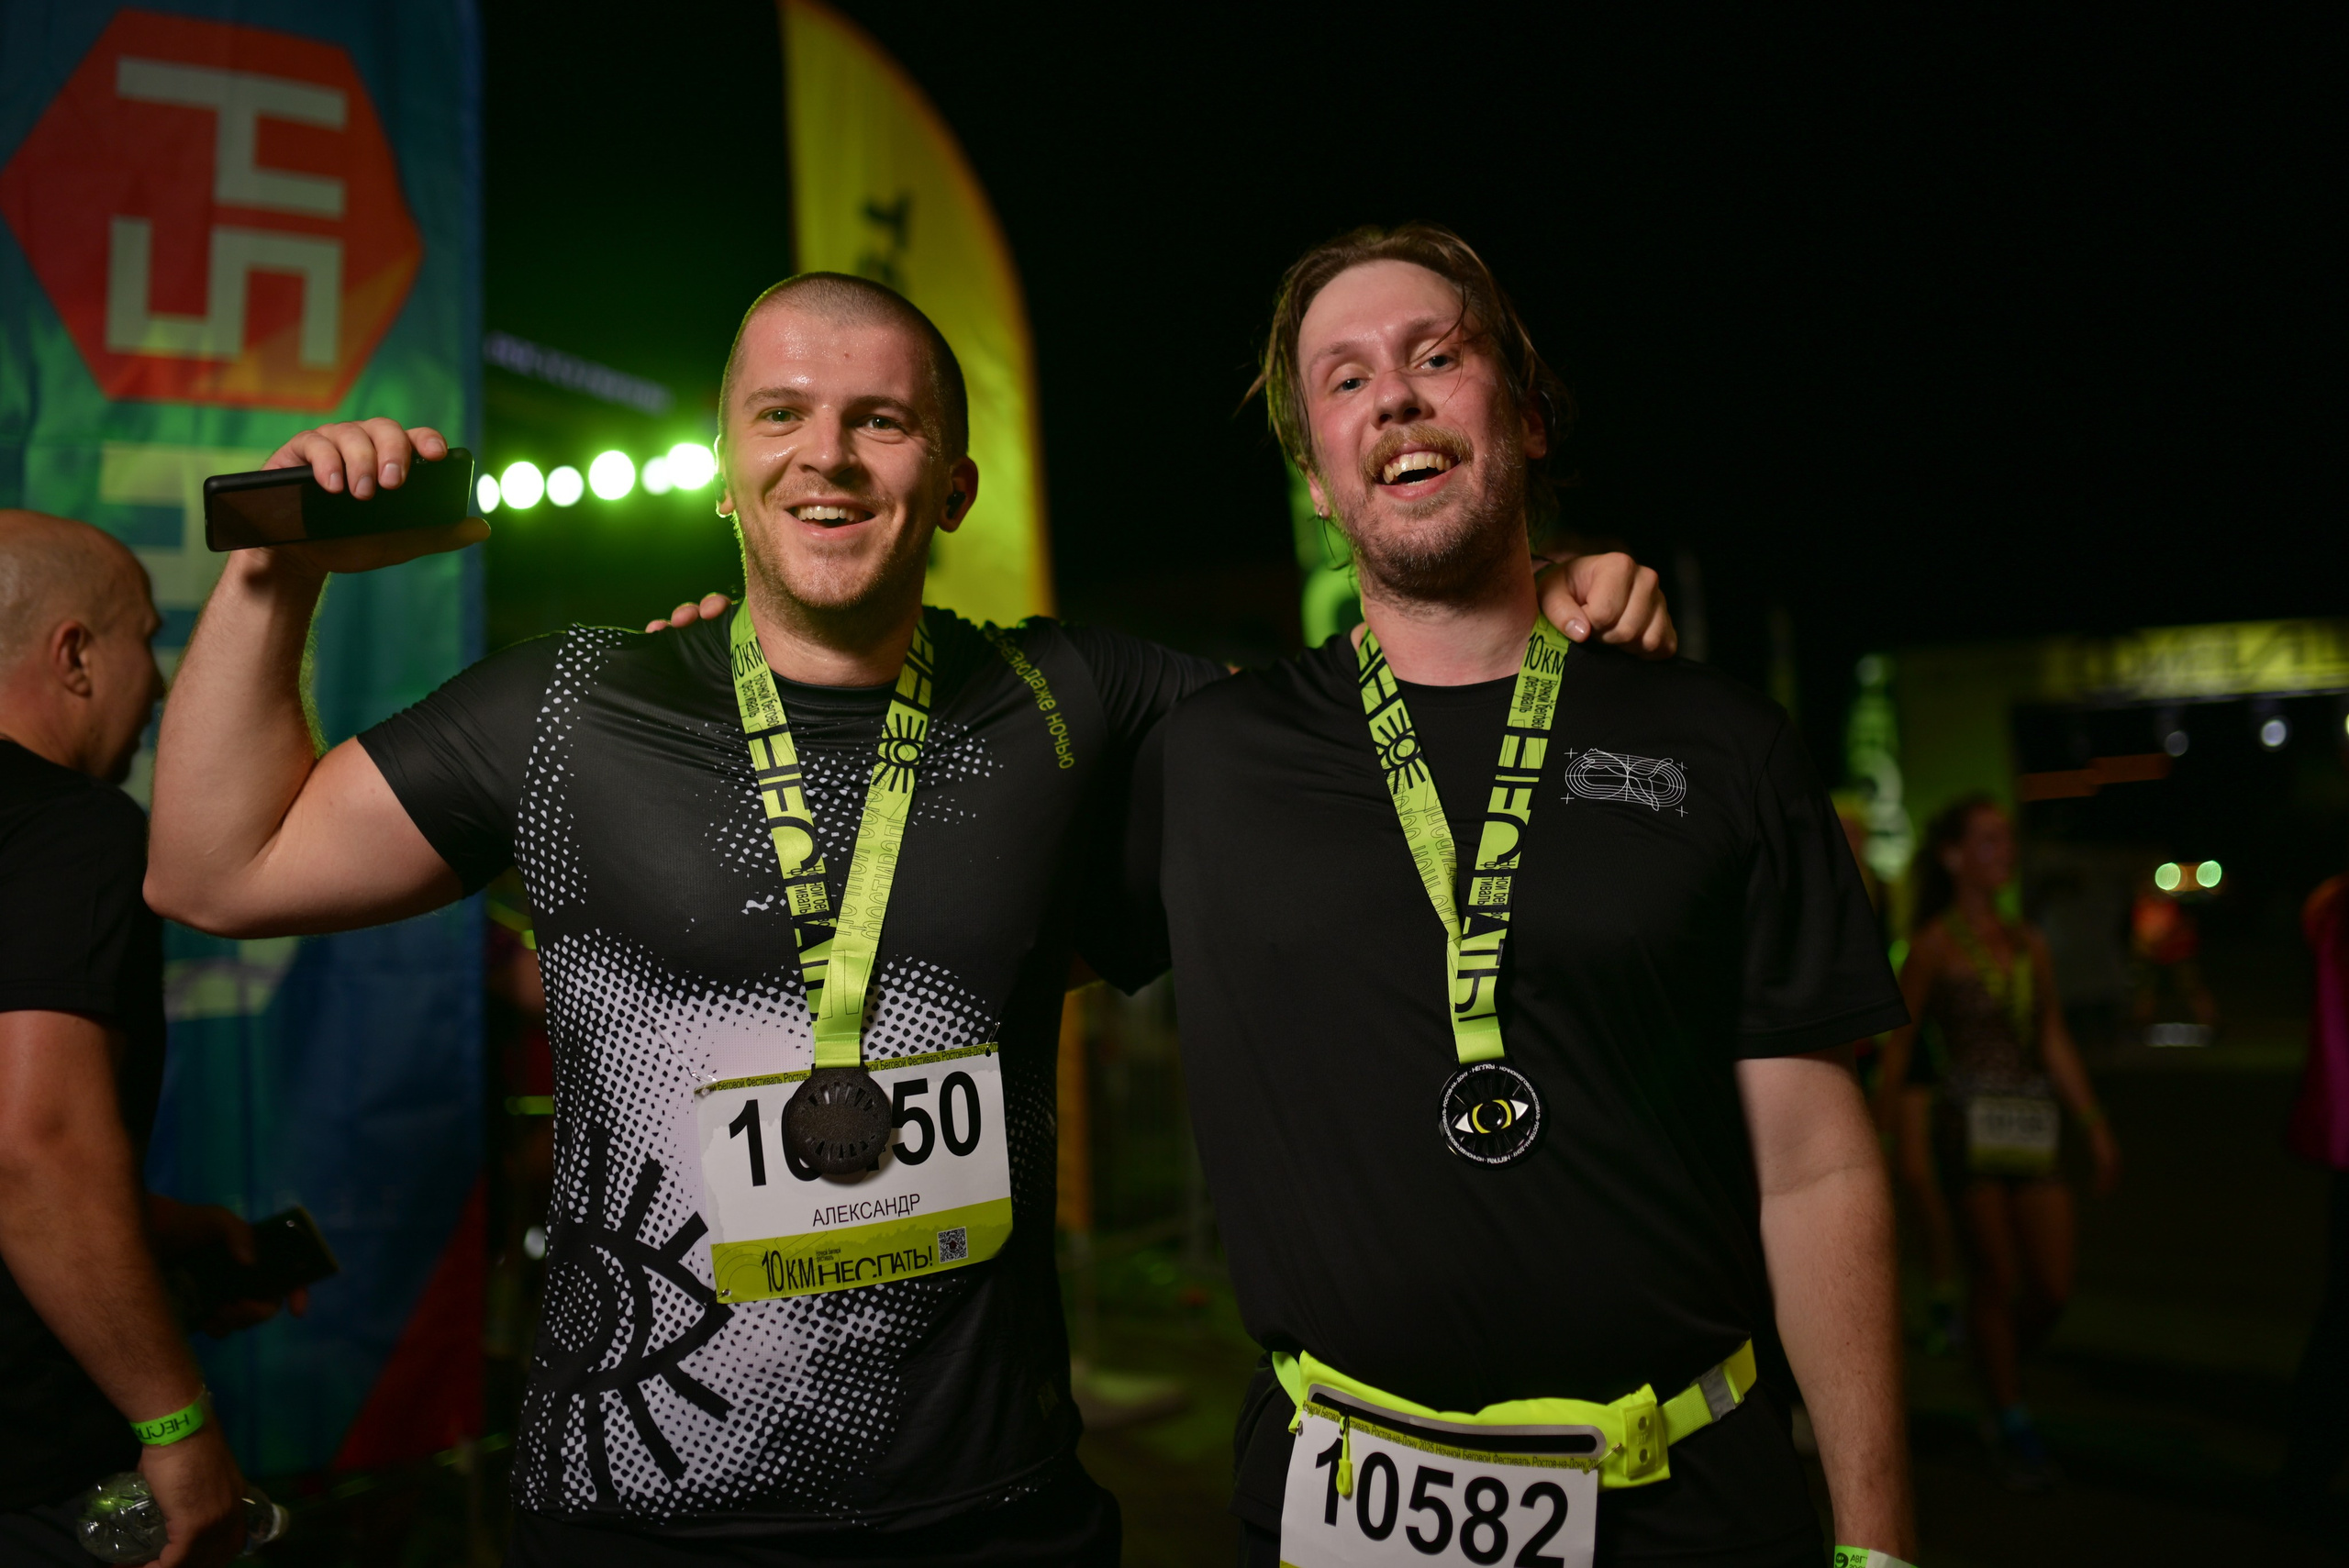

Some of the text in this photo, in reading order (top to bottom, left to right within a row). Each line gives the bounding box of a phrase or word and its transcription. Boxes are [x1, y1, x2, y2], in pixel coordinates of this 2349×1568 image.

[762, 700, 780, 728] бегово
[1023, 668, 1056, 711] даже
[1045, 712, 1074, 770] ночью
[1531, 702, 1553, 728] бегово
[718, 1077, 745, 1091] Беговой
[745, 1074, 783, 1087] Фестиваль
[880, 1059, 907, 1071] Беговой
[907, 1054, 941, 1066] Фестиваль
[729, 1071, 982, 1186] 150
[812, 1193, 920, 1228] АЛЕКСАНДР
[1371, 1425, 1418, 1450] Ростов-на-Дону
[1418, 1440, 1435, 1454] 2025
[1435, 1443, 1462, 1460] Ночной
[1462, 1451, 1491, 1463] Беговой
[1492, 1453, 1531, 1467] Фестиваль
[1531, 1456, 1586, 1470] Ростов-на-Дону
[1316, 1438, 1569, 1568] 10582
